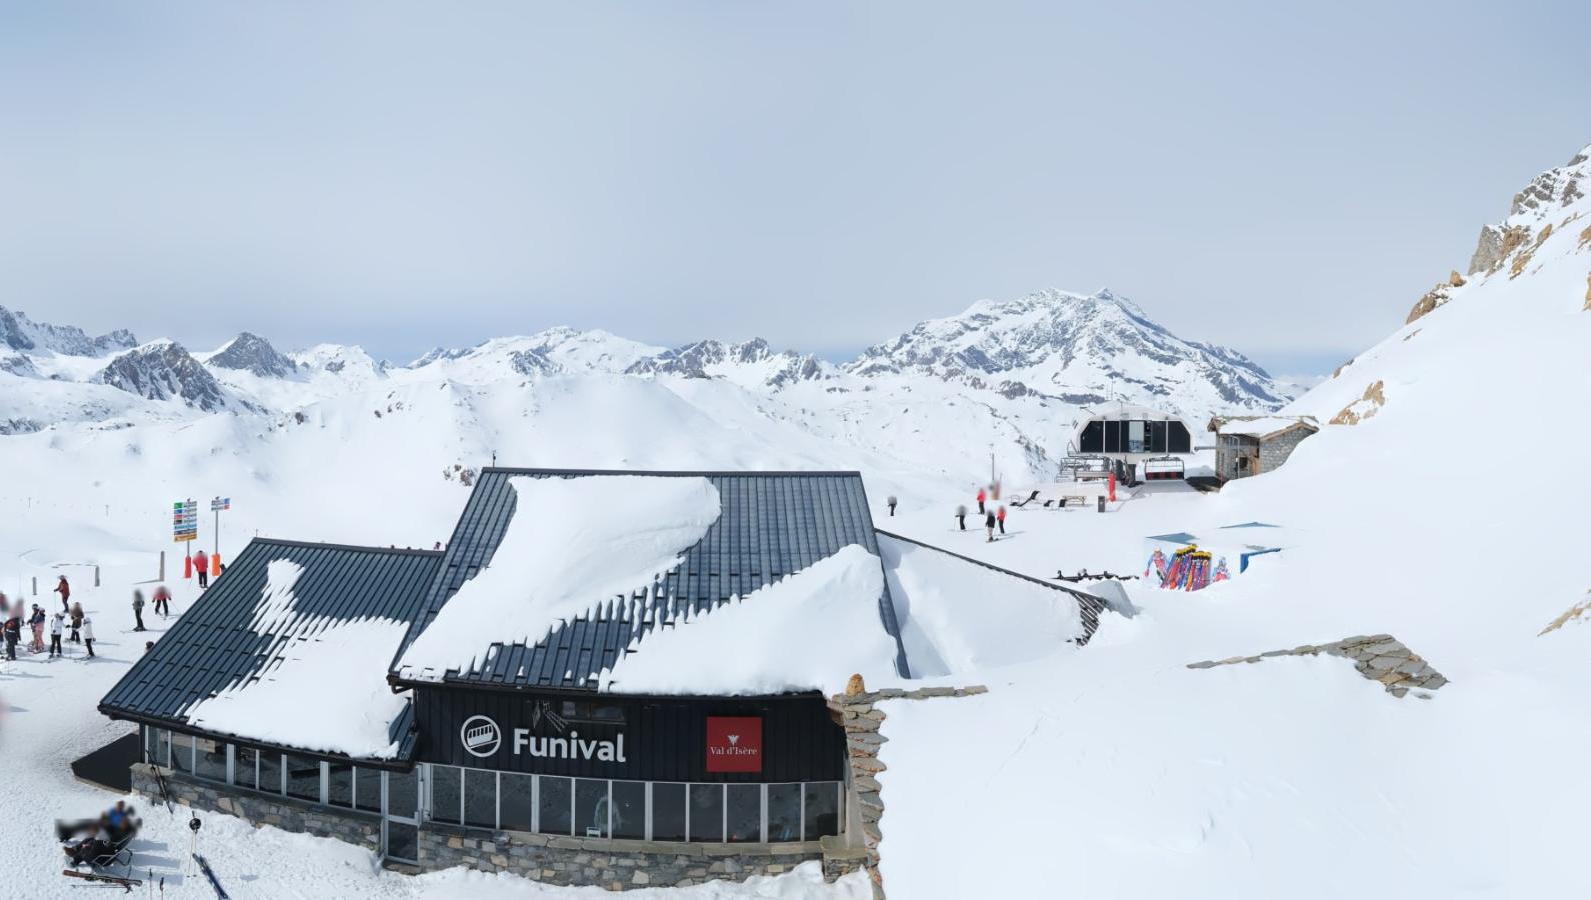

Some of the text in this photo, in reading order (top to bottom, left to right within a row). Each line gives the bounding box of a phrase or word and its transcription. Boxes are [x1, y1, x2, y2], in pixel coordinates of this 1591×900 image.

[514, 728, 626, 763] Funival
[710, 746, 758, 755] Val d'Isère
